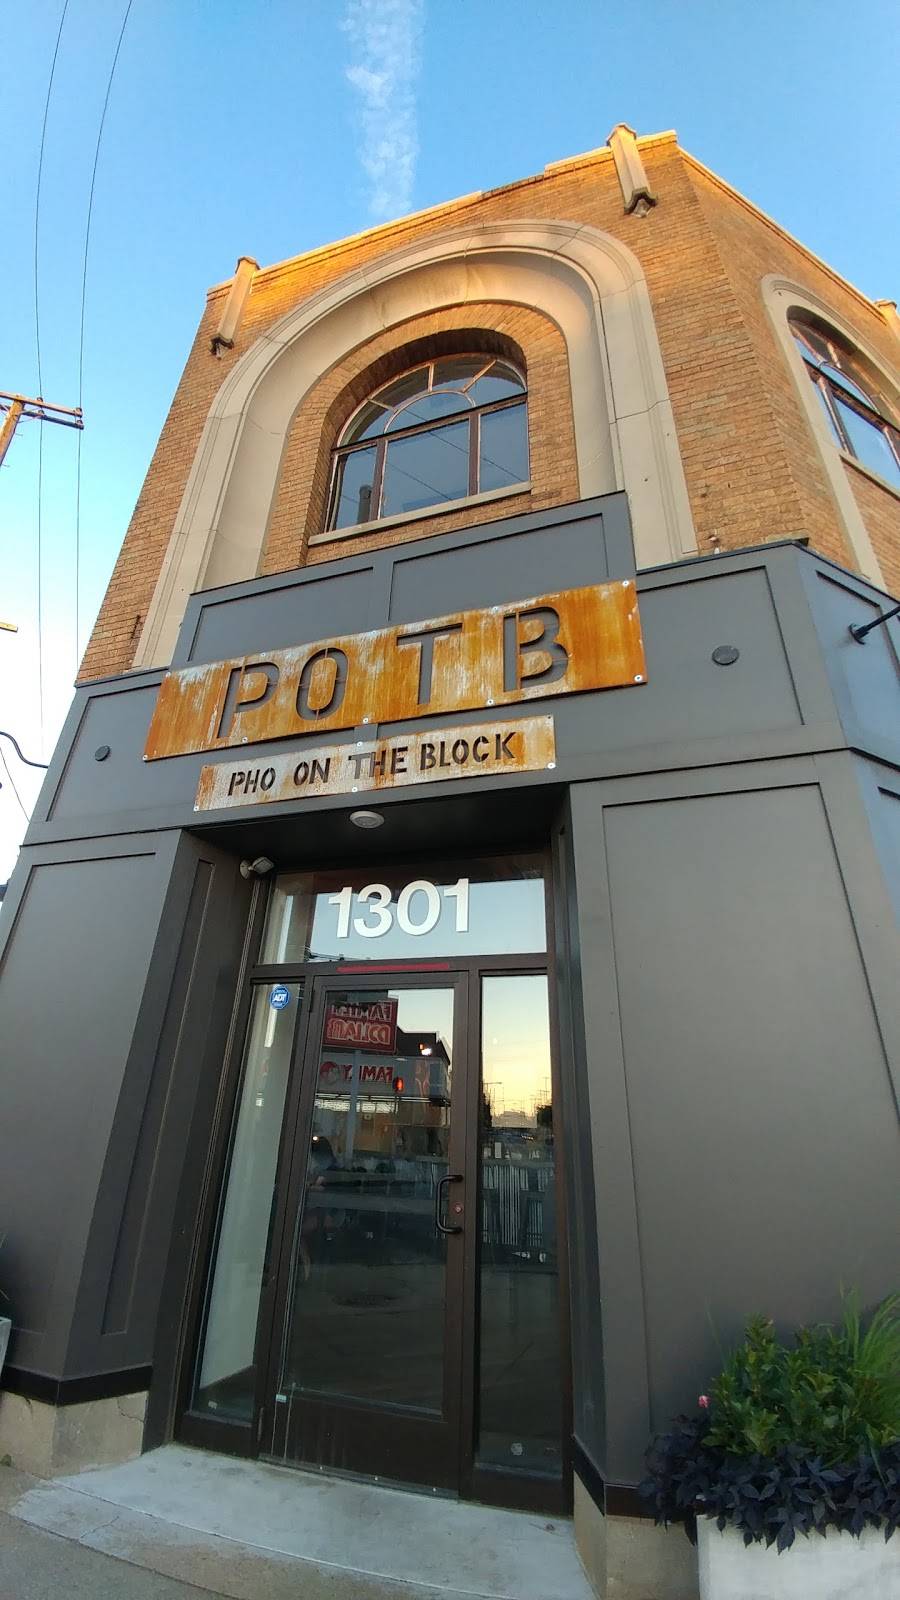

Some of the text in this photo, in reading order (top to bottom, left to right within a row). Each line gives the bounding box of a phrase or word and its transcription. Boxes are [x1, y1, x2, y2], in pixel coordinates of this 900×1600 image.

[216, 606, 569, 739] POTB
[228, 731, 516, 796] PHO ON THE BLOCK
[328, 878, 470, 938] 1301
